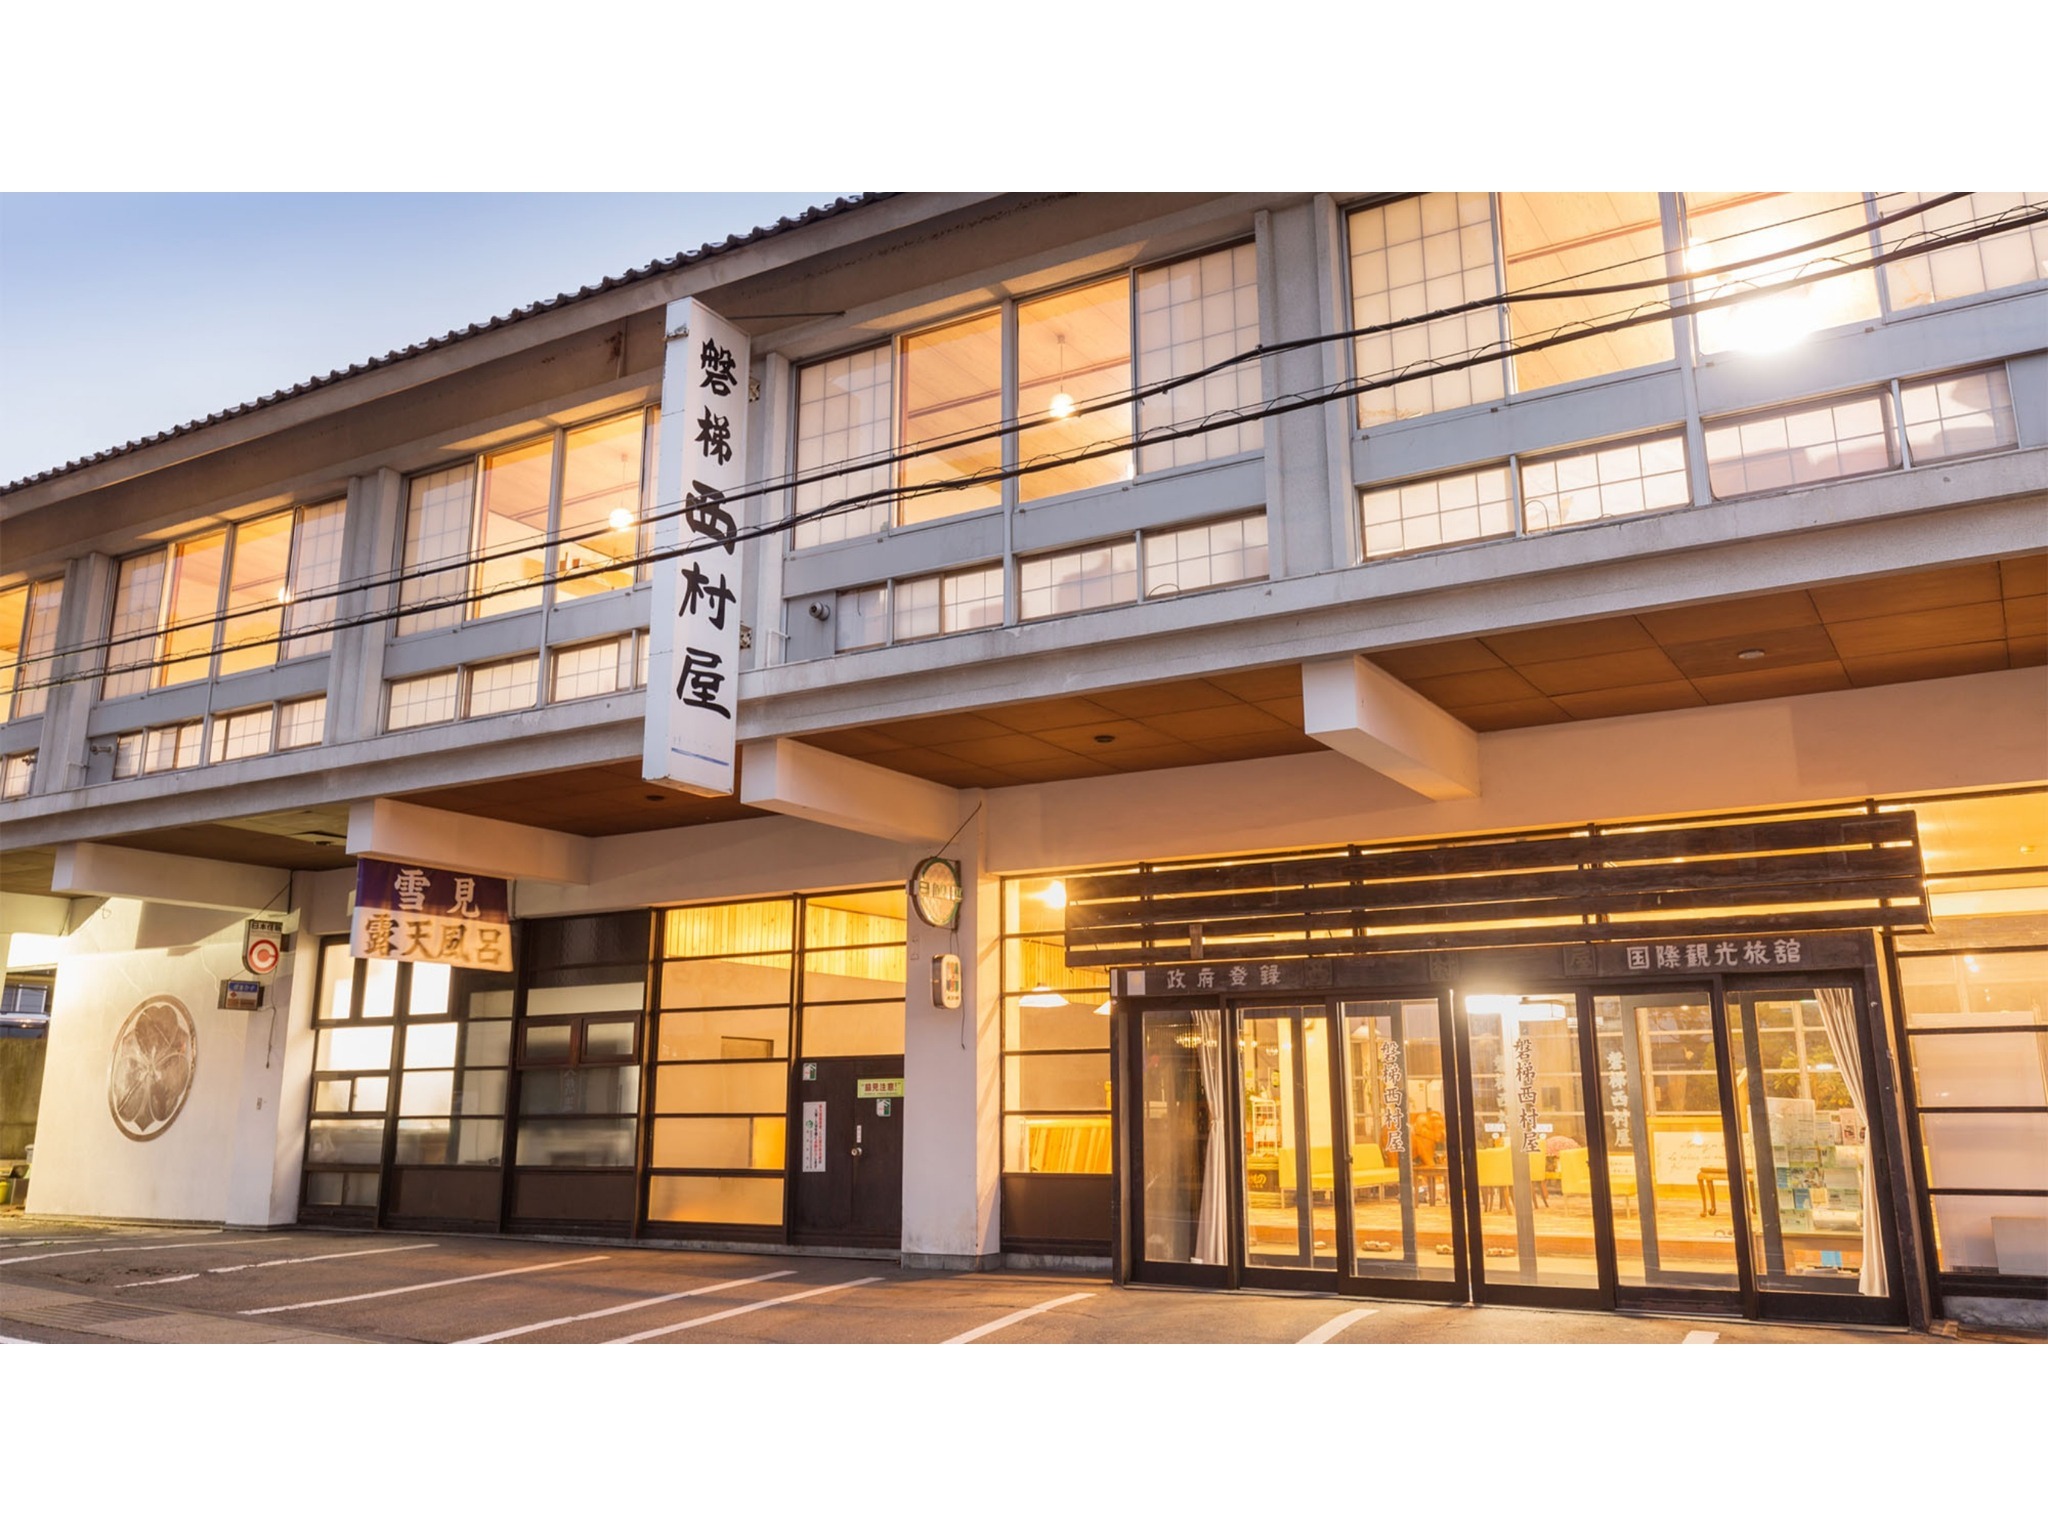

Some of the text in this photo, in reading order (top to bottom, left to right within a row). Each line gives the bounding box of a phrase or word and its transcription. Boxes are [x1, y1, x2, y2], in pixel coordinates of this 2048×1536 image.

[676, 337, 738, 720] 磐梯西村屋
[394, 868, 481, 918] 雪見
[364, 914, 503, 964] 露天風呂
[1166, 964, 1282, 989] 政府登録
[1381, 1041, 1406, 1152] 磐梯西村屋
[1513, 1038, 1541, 1152] 磐梯西村屋
